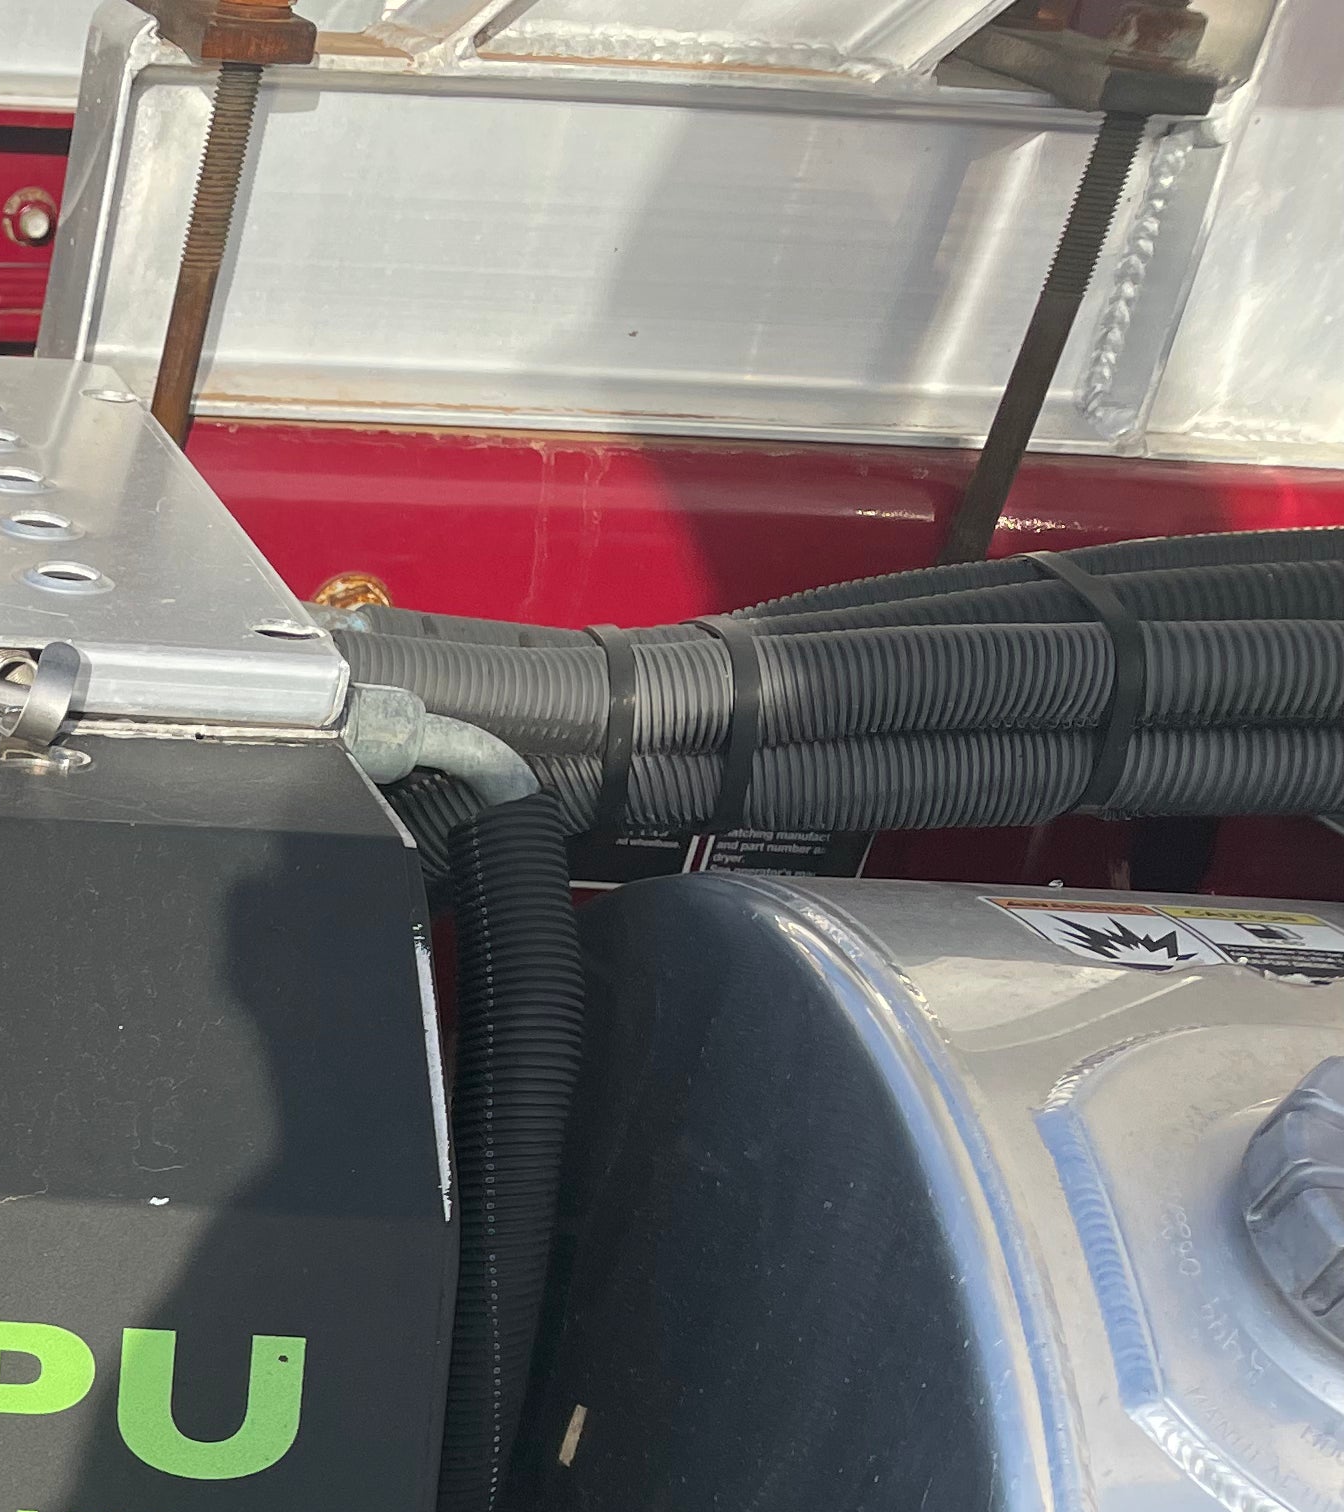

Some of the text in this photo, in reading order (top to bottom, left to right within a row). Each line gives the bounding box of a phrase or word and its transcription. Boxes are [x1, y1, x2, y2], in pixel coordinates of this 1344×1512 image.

[724, 828, 774, 842] atching
[716, 840, 739, 850] and
[740, 842, 765, 852] part
[767, 844, 812, 854] number
